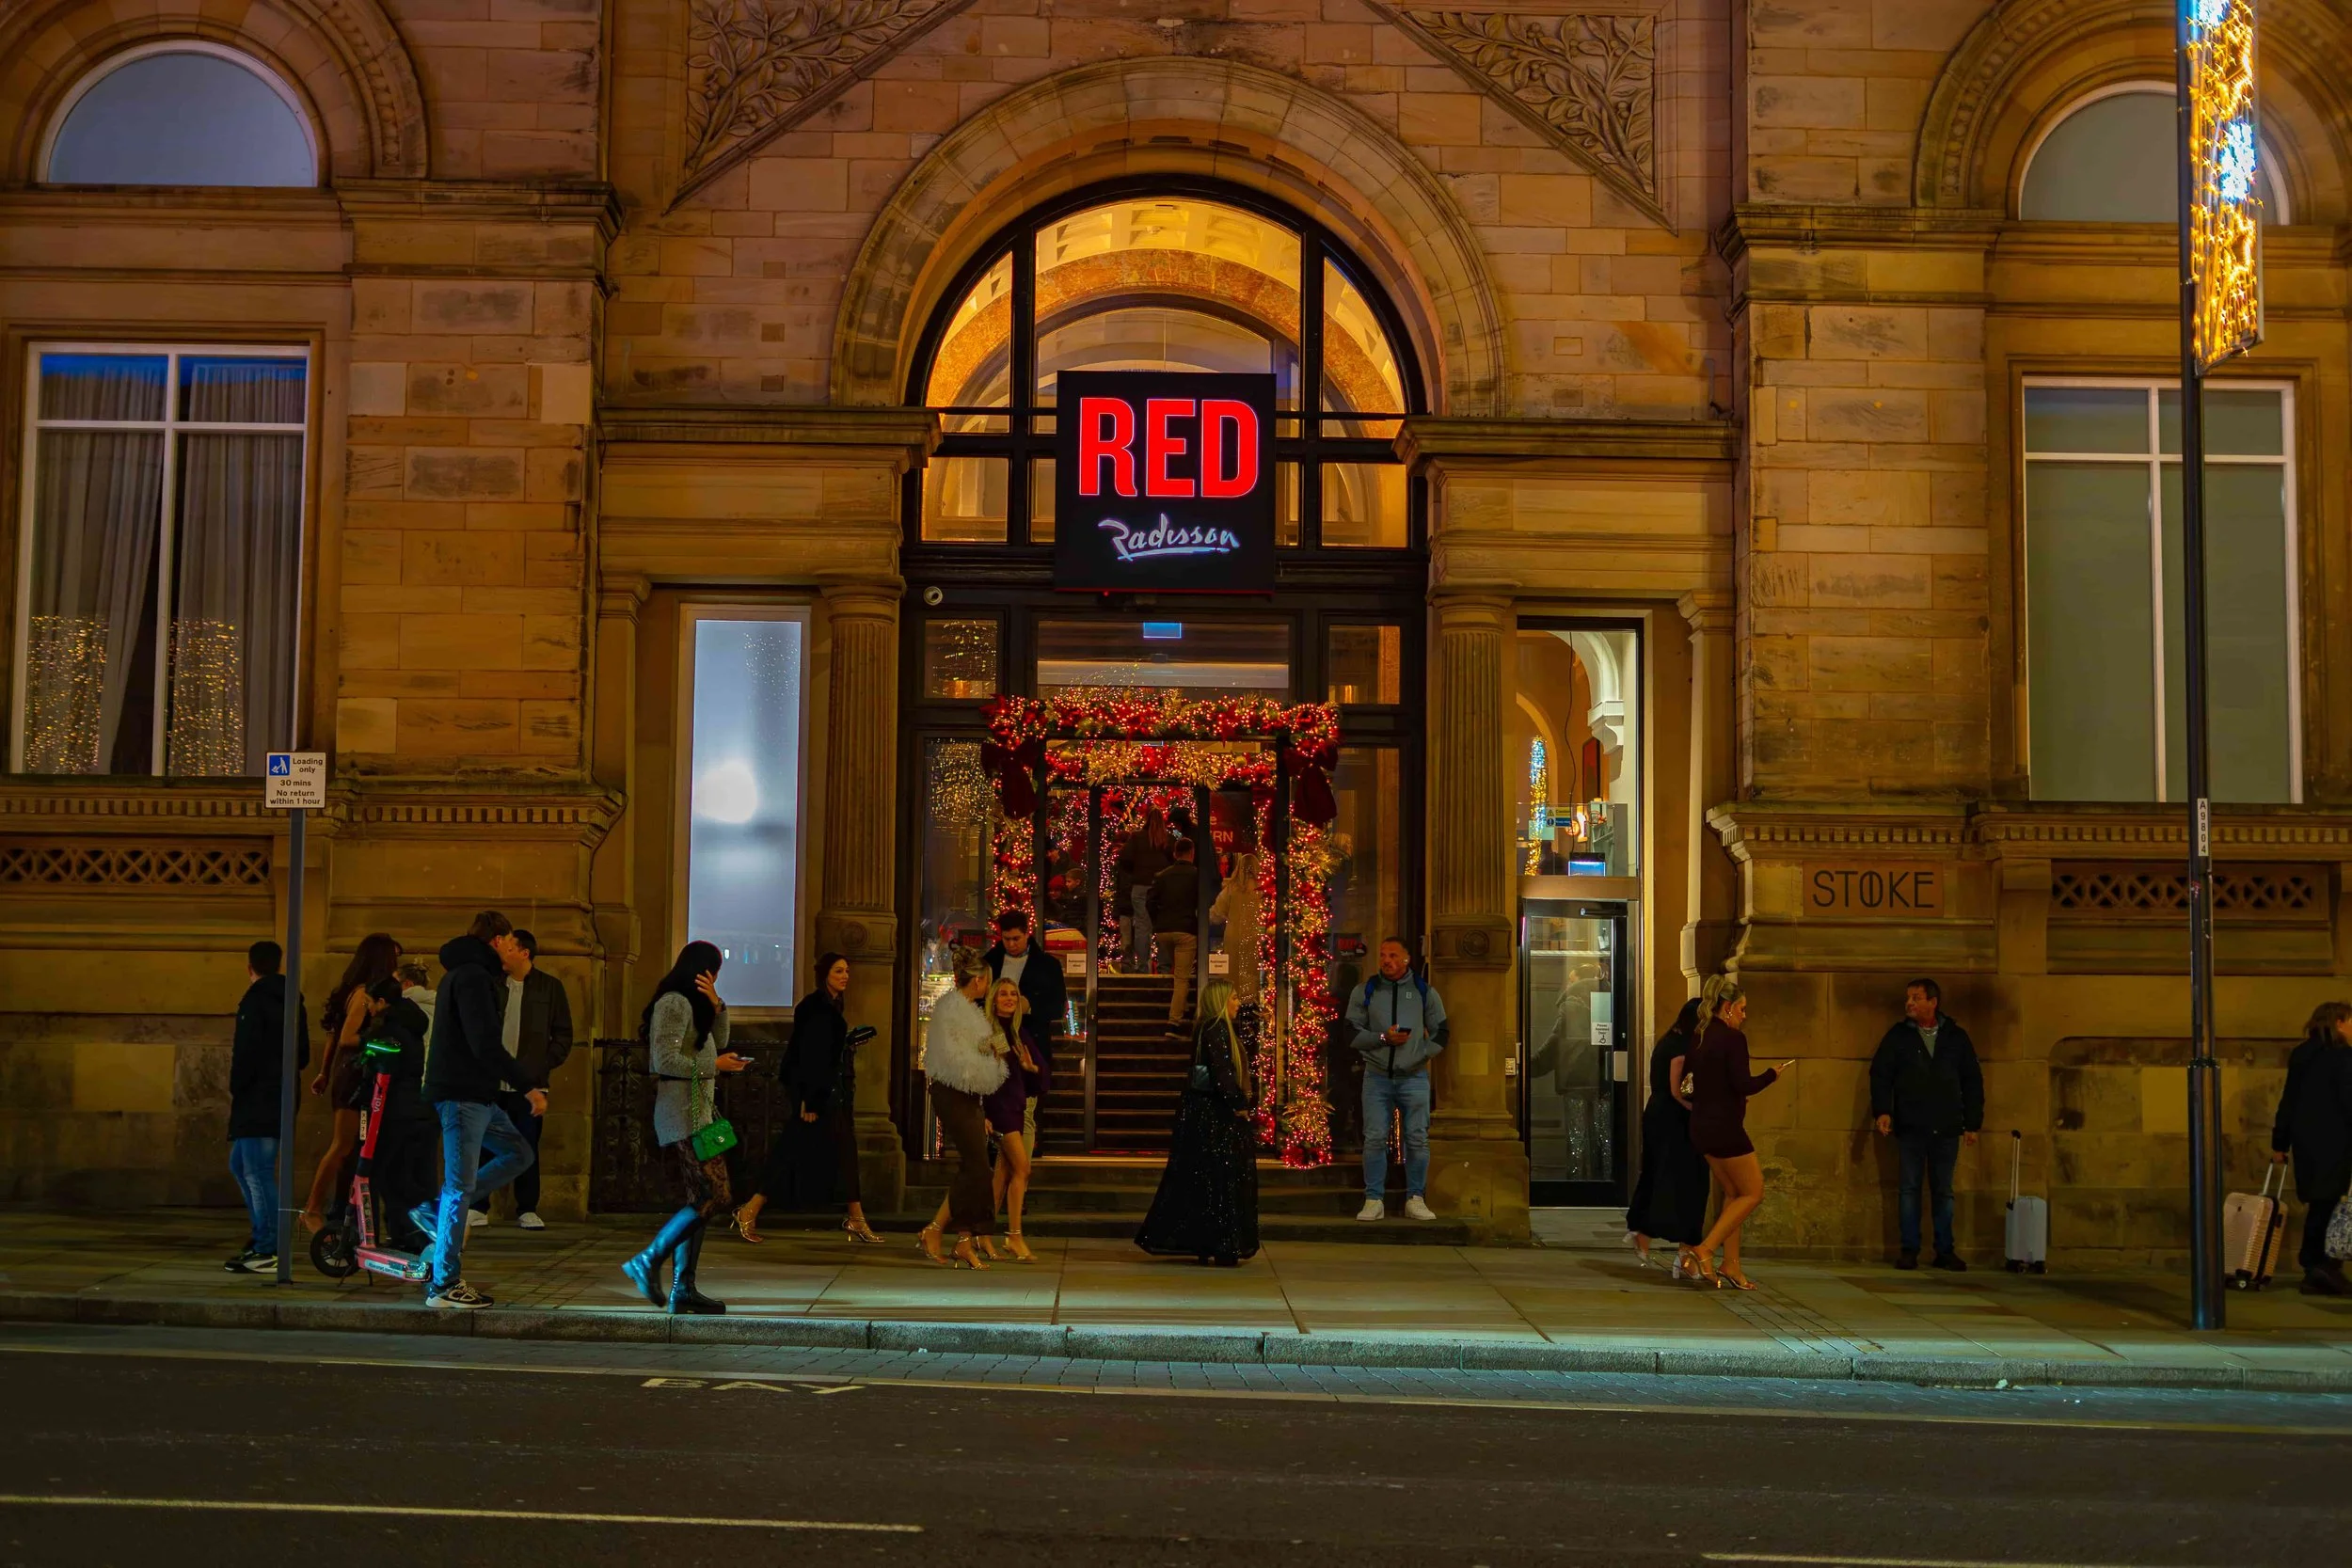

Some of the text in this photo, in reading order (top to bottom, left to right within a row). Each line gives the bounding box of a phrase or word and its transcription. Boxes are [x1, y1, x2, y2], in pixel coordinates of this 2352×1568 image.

[1079, 397, 1259, 499] RED
[1098, 513, 1240, 562] Radisson
[1812, 870, 1934, 909] STOKE
[640, 1378, 866, 1395] BAY
